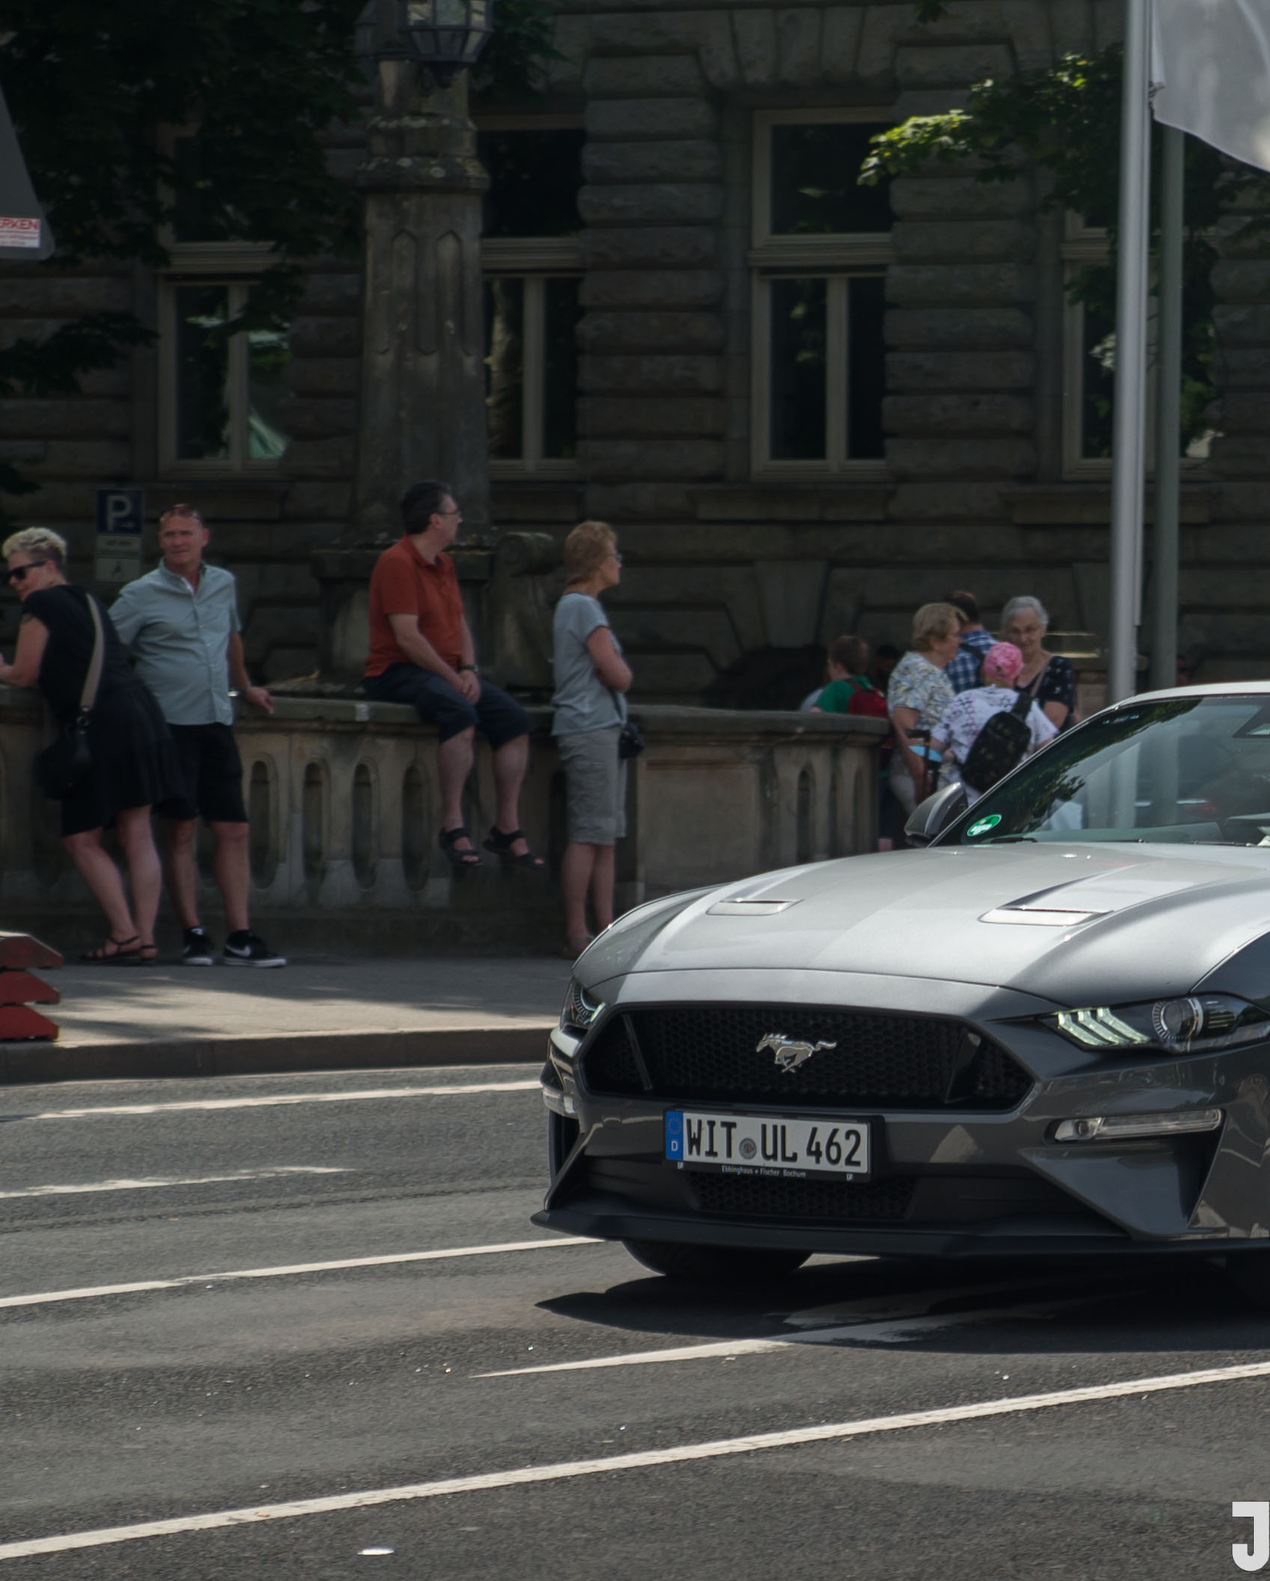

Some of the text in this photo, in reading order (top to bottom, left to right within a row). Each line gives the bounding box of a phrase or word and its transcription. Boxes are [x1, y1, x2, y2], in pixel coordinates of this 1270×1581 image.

[107, 496, 132, 531] P
[671, 1118, 861, 1167] D WIT UL 462
[760, 1167, 780, 1176] Fischer
[783, 1169, 806, 1178] Bochum
